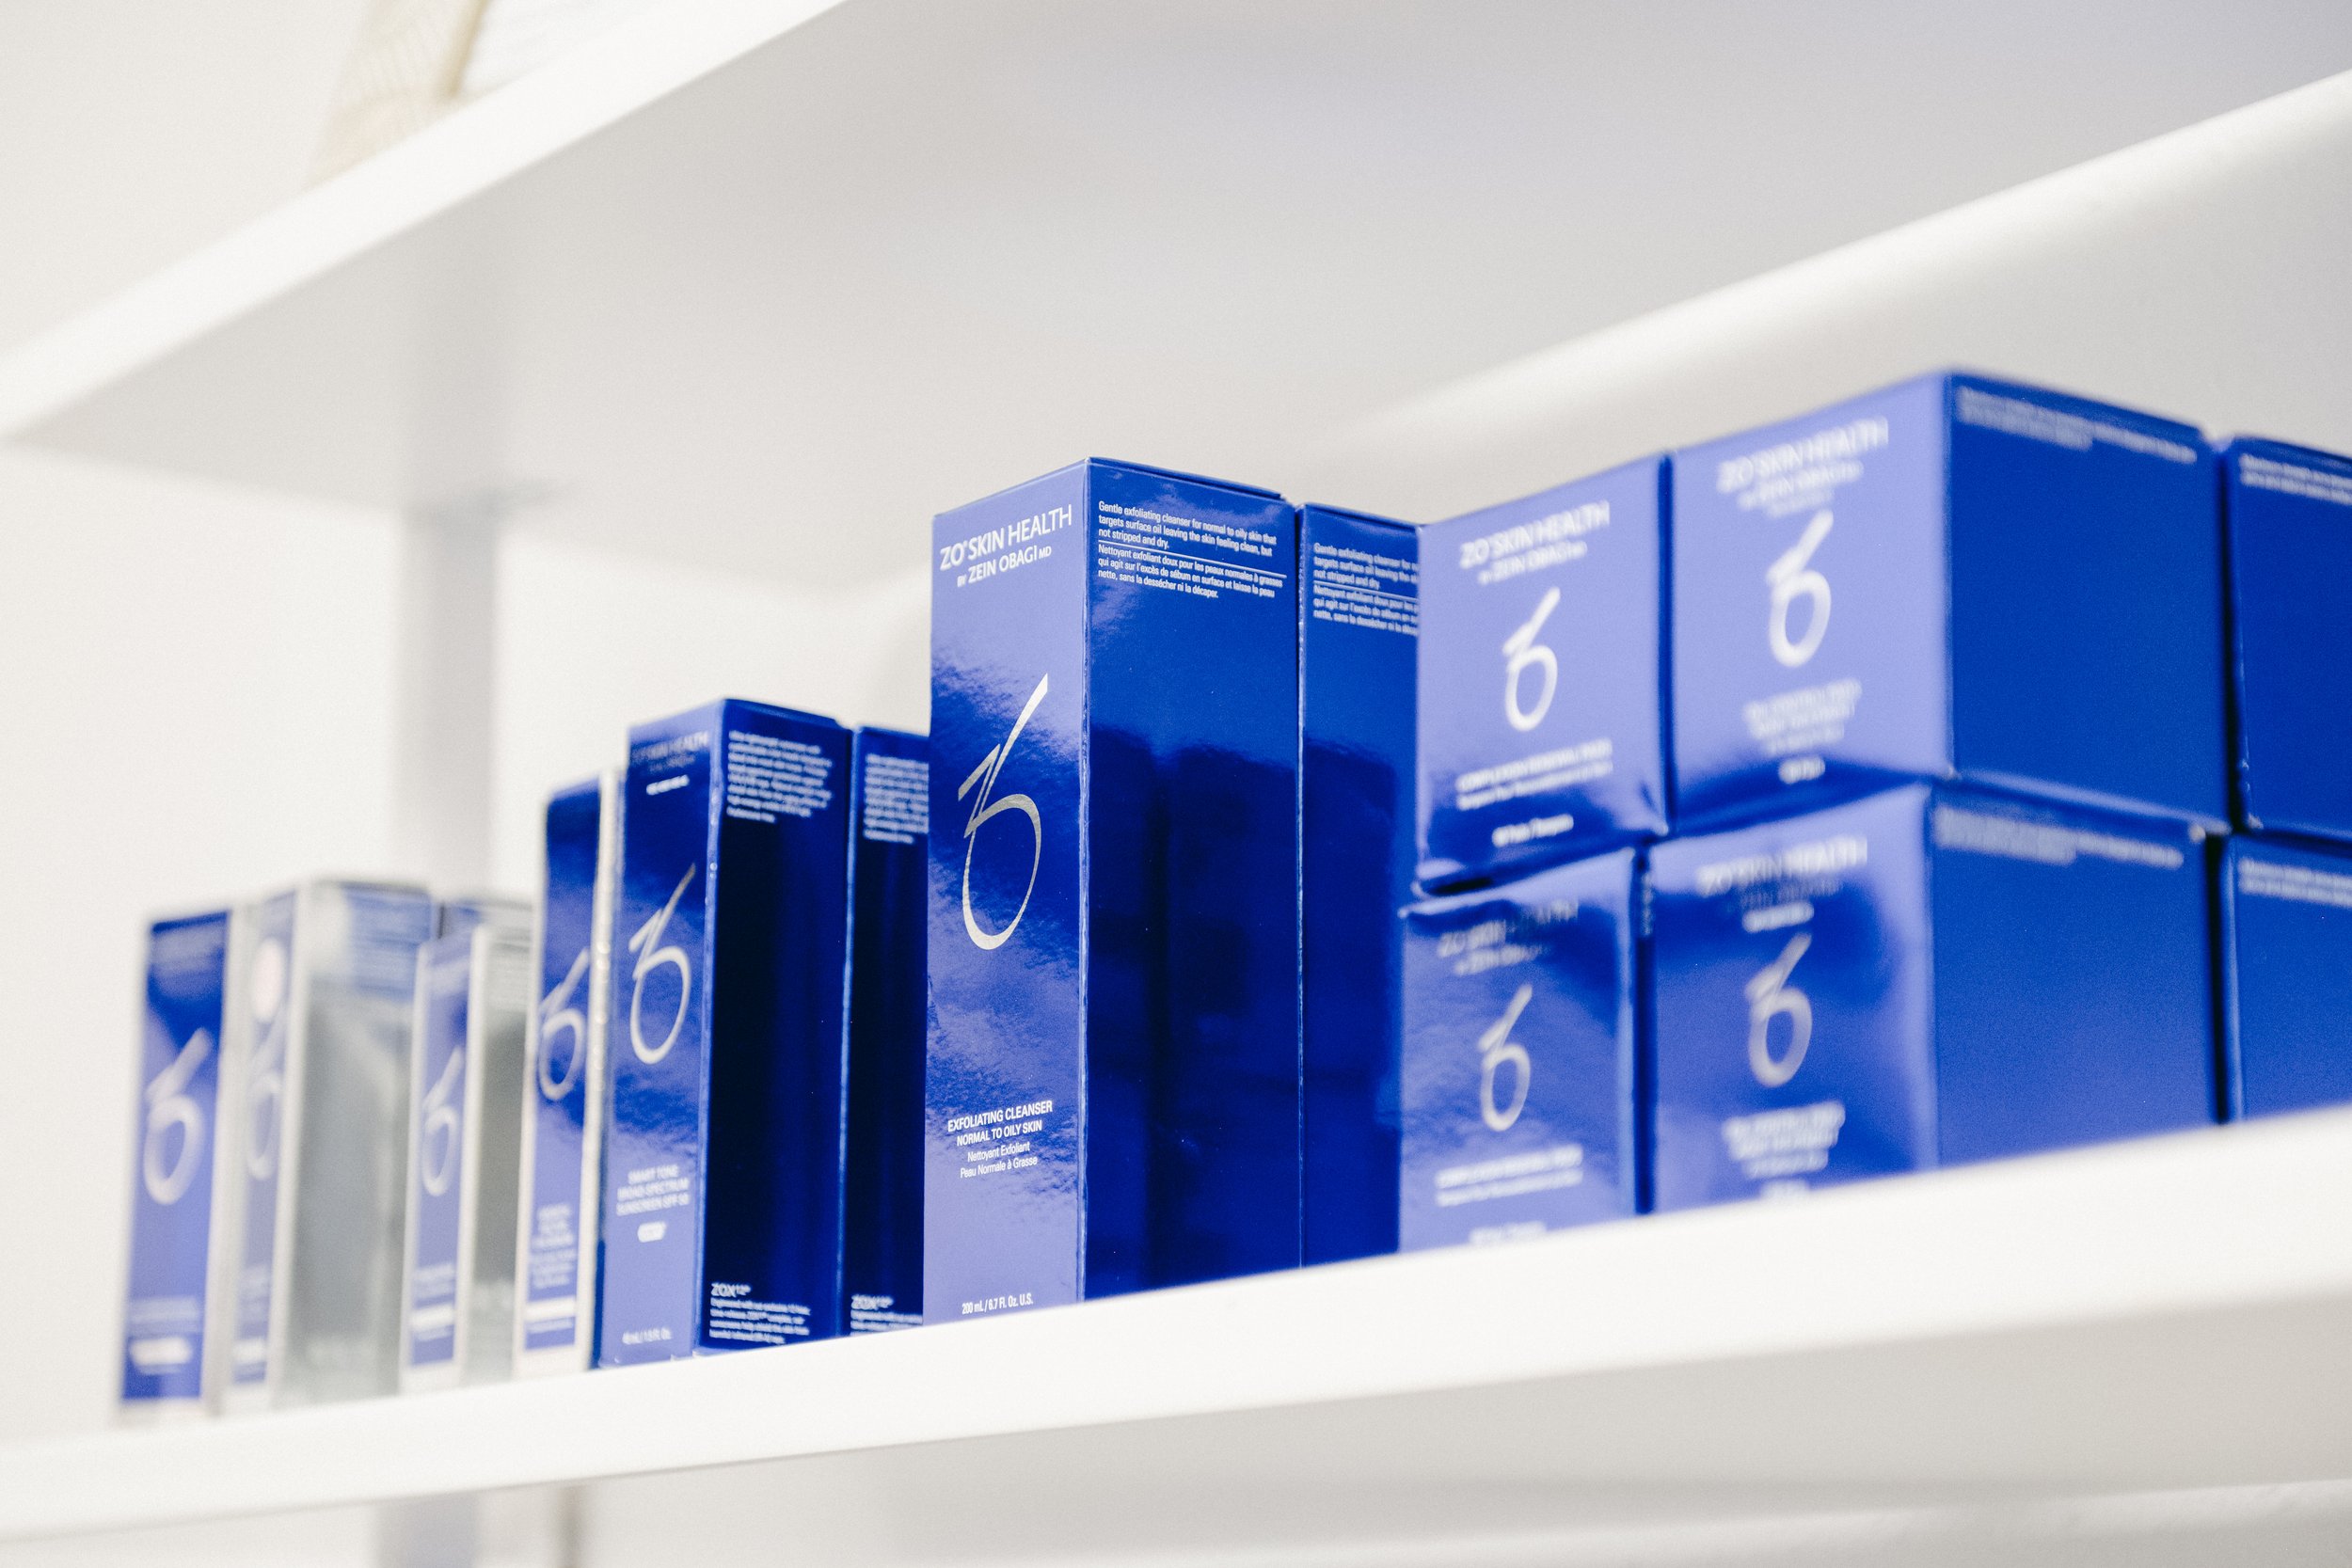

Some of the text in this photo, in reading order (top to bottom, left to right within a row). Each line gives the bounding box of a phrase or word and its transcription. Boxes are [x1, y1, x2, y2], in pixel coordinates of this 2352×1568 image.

[967, 527, 1005, 561] SKIN
[1008, 504, 1072, 546] HEALTH
[1099, 500, 1277, 546] Gentle exfoliating cleanser for normal to oily skin that
[1099, 515, 1272, 557] targets surface oil leaving the skin feeling clean, but
[1099, 529, 1169, 549] not stripped and dry.
[968, 559, 996, 583] ZEIN
[999, 546, 1037, 572] OBAGI
[1039, 546, 1052, 559] MD
[1099, 544, 1132, 559] Nettoyant
[1133, 550, 1161, 562] exfoliant
[1163, 556, 1178, 566] doux
[1179, 560, 1193, 570] pour
[1195, 561, 1204, 572] les
[1204, 565, 1223, 576] peaux
[1225, 568, 1253, 581] normales
[1259, 576, 1283, 589] grasses
[1099, 557, 1108, 567] qui
[1110, 559, 1123, 570] agit
[1125, 562, 1136, 572] sur
[1160, 566, 1168, 577] de
[1170, 568, 1191, 581] sébum
[1192, 574, 1200, 583] en
[1201, 576, 1225, 588] surface
[1225, 579, 1232, 589] et
[1232, 580, 1251, 593] laisse
[1251, 584, 1259, 594] la
[1259, 587, 1275, 598] peau
[1099, 569, 1118, 580] nette,
[1120, 573, 1135, 583] sans
[1136, 574, 1142, 584] la
[1144, 576, 1176, 591] dessécher
[1177, 582, 1184, 591] ni
[1185, 583, 1191, 593] la
[948, 1101, 1053, 1132] EXFOLIATING CLEANSER
[956, 1119, 1042, 1147] NORMAL TO OILY SKIN
[960, 1156, 1038, 1178] Peau Normale à Grasse
[967, 1142, 1031, 1163] Nettoyant Exfoliant
[961, 1302, 973, 1315] 200
[988, 1297, 997, 1310] 6.7
[1020, 1292, 1033, 1306] U.S.
